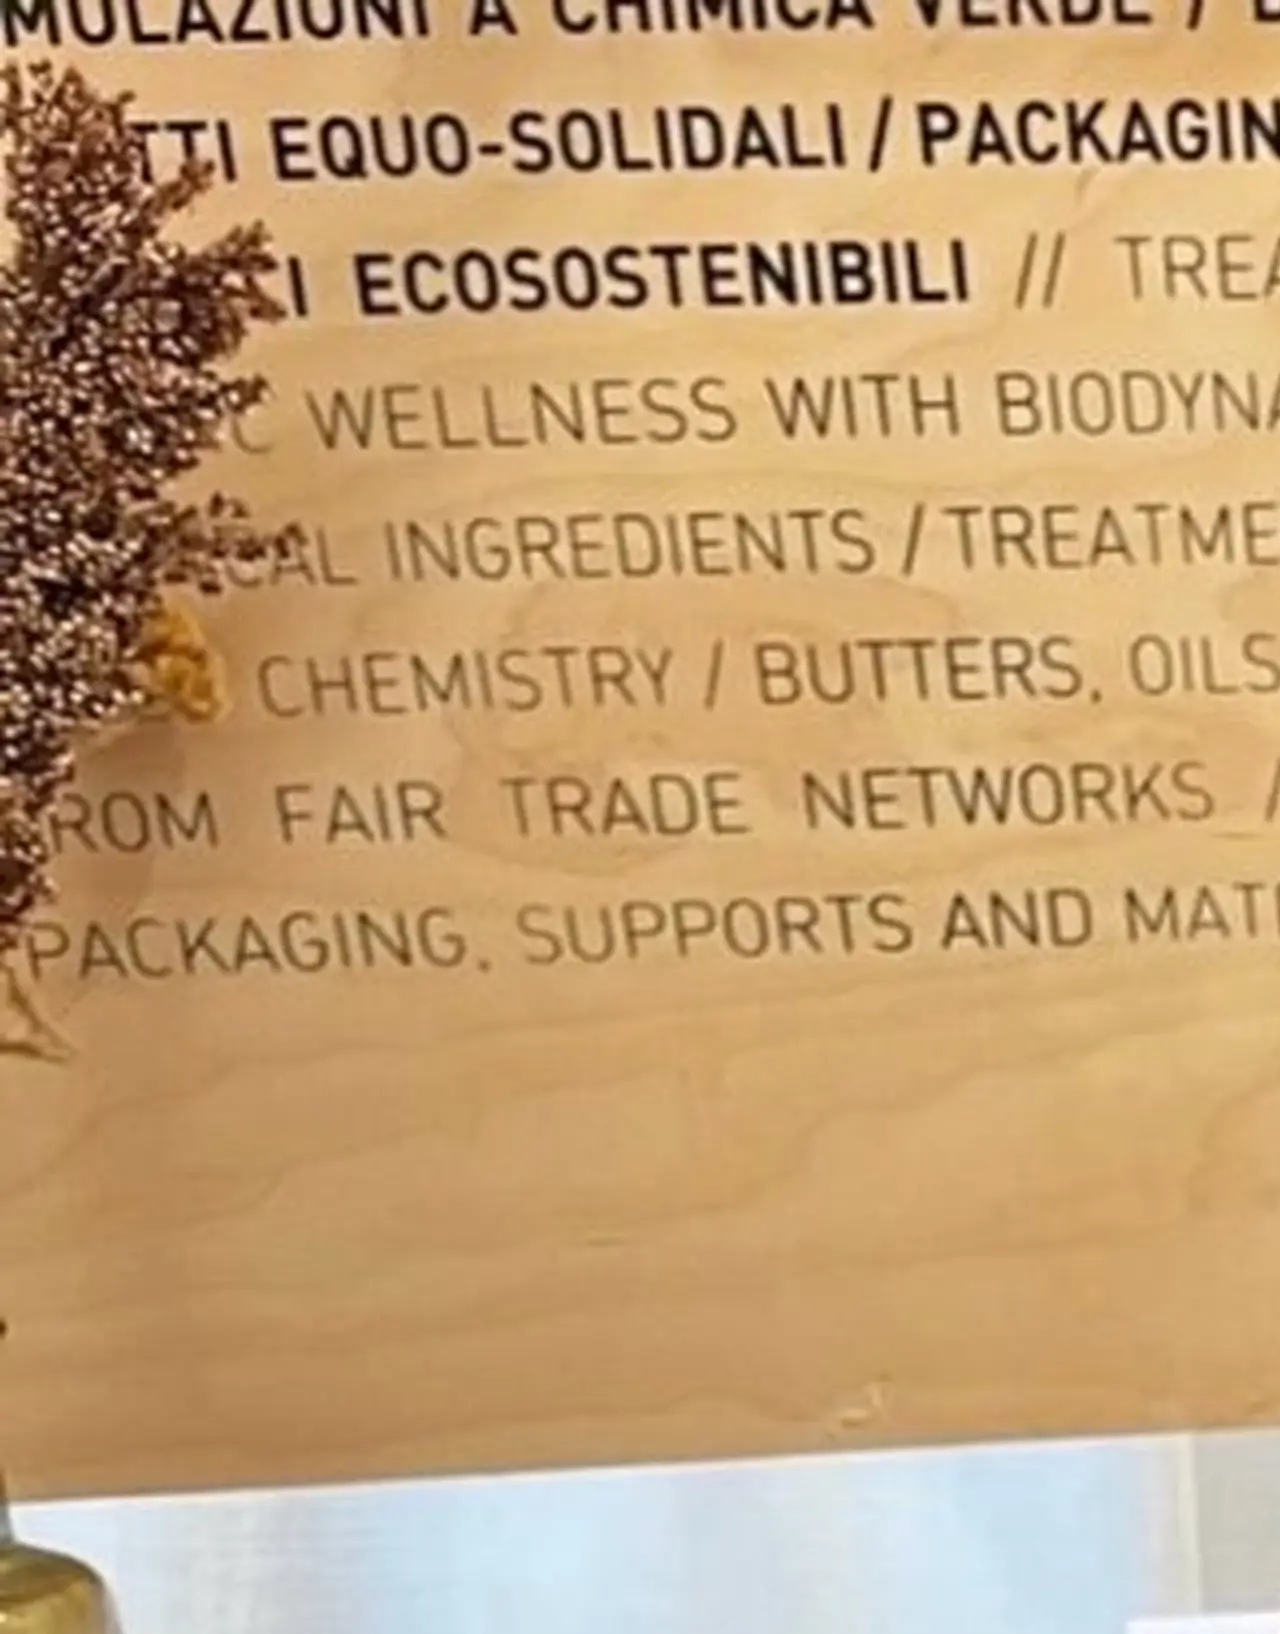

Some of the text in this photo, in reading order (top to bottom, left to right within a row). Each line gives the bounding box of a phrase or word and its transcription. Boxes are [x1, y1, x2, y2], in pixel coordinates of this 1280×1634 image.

[126, 118, 237, 182] TTI
[269, 103, 847, 181] EQUO-SOLIDALI
[353, 238, 969, 316] ECOSOSTENIBILI
[306, 377, 737, 449] WELLNESS
[764, 373, 959, 438] WITH
[385, 509, 875, 580] INGREDIENTS
[259, 646, 672, 717] CHEMISTRY
[46, 788, 220, 853] ROM
[276, 781, 446, 843] FAIR
[501, 773, 748, 835] TRADE
[802, 761, 1214, 829] NETWORKS
[517, 893, 912, 964] SUPPORTS
[941, 888, 1092, 949] AND
